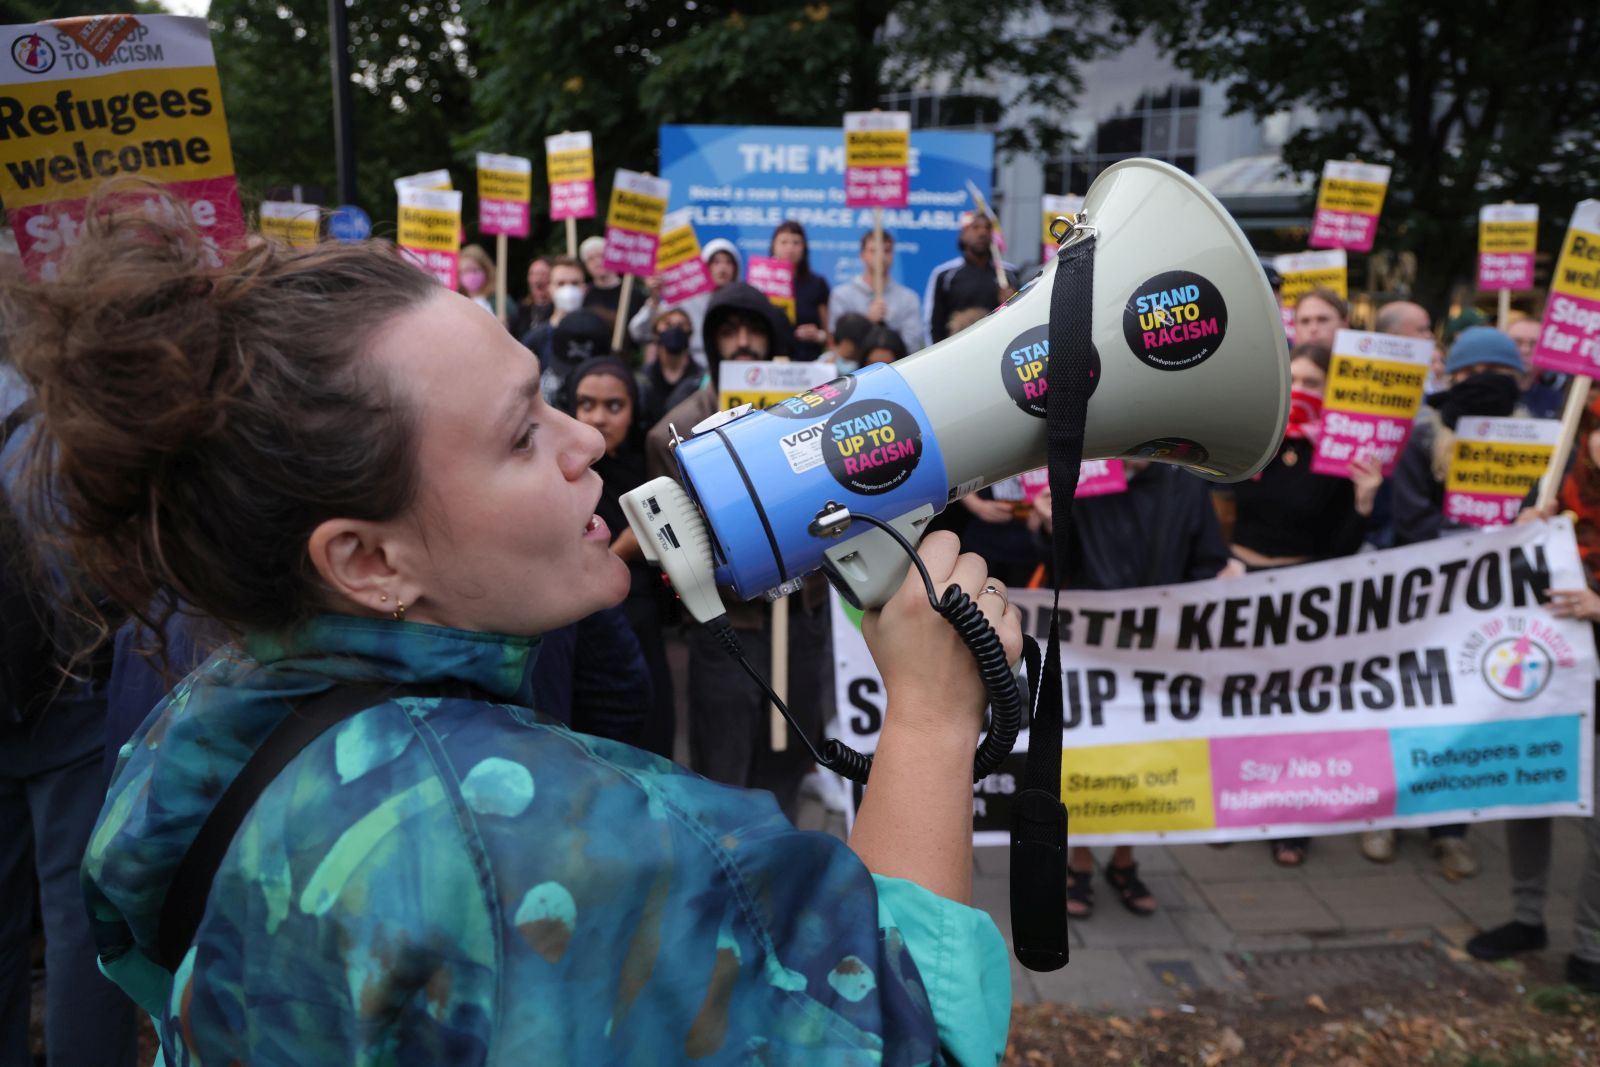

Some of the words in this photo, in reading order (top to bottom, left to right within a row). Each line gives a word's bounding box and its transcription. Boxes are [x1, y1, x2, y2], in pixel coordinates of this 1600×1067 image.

[62, 52, 89, 71] TO
[0, 87, 213, 140] Refugees
[5, 136, 212, 191] welcome
[738, 144, 809, 174] THE
[1136, 284, 1200, 313] STAND
[1139, 309, 1167, 331] UP
[1171, 302, 1200, 324] TO
[1143, 317, 1219, 349] RACISM
[1016, 361, 1043, 382] UP
[831, 409, 892, 440] STAND
[837, 435, 865, 457] UP
[867, 426, 896, 447] TO
[843, 438, 915, 476] RACISM
[1456, 469, 1534, 487] welcom
[1021, 606, 1158, 649] RTH
[1177, 545, 1552, 651] KENSINGTON
[1133, 670, 1204, 723] TO
[1221, 648, 1456, 719] RACISM
[1411, 739, 1519, 770] Refugees
[1526, 739, 1563, 758] are
[1068, 771, 1139, 792] Stamp
[1145, 768, 1179, 787] out
[1241, 760, 1283, 784] Say
[1288, 758, 1323, 778] No
[1328, 757, 1353, 777] to
[1410, 770, 1508, 796] welcome
[1517, 765, 1567, 785] here
[1068, 797, 1196, 818] ntisemitism
[1220, 784, 1380, 811] Islamophobia
